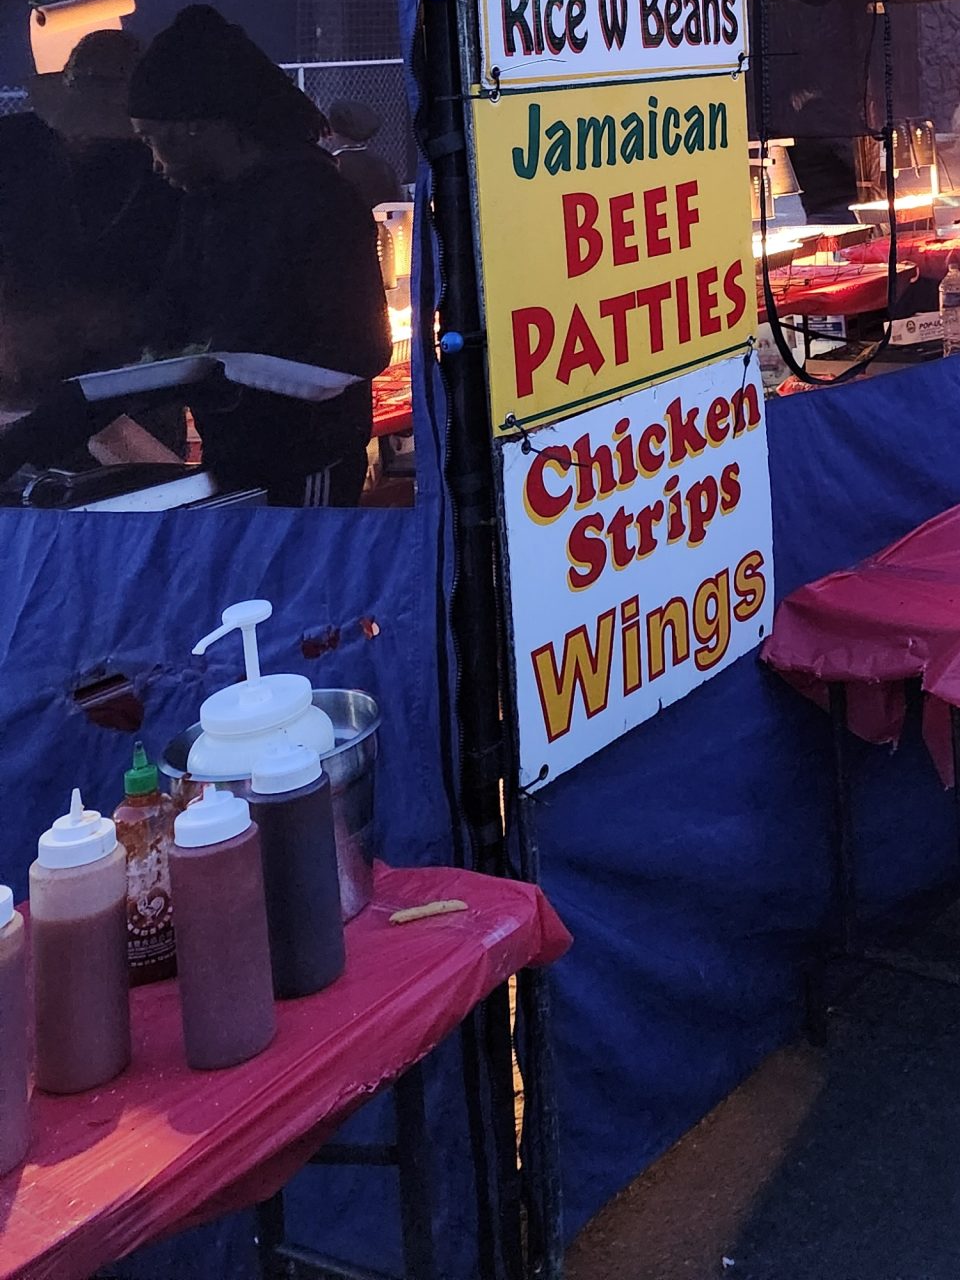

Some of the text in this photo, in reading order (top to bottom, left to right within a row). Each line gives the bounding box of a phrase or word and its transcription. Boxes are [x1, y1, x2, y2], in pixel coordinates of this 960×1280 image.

[512, 96, 729, 180] Jamaican
[562, 180, 701, 279] BEEF
[511, 259, 748, 400] PATTIES
[523, 382, 763, 527] Chicken
[566, 462, 743, 593] Strips
[530, 549, 767, 745] Wings
